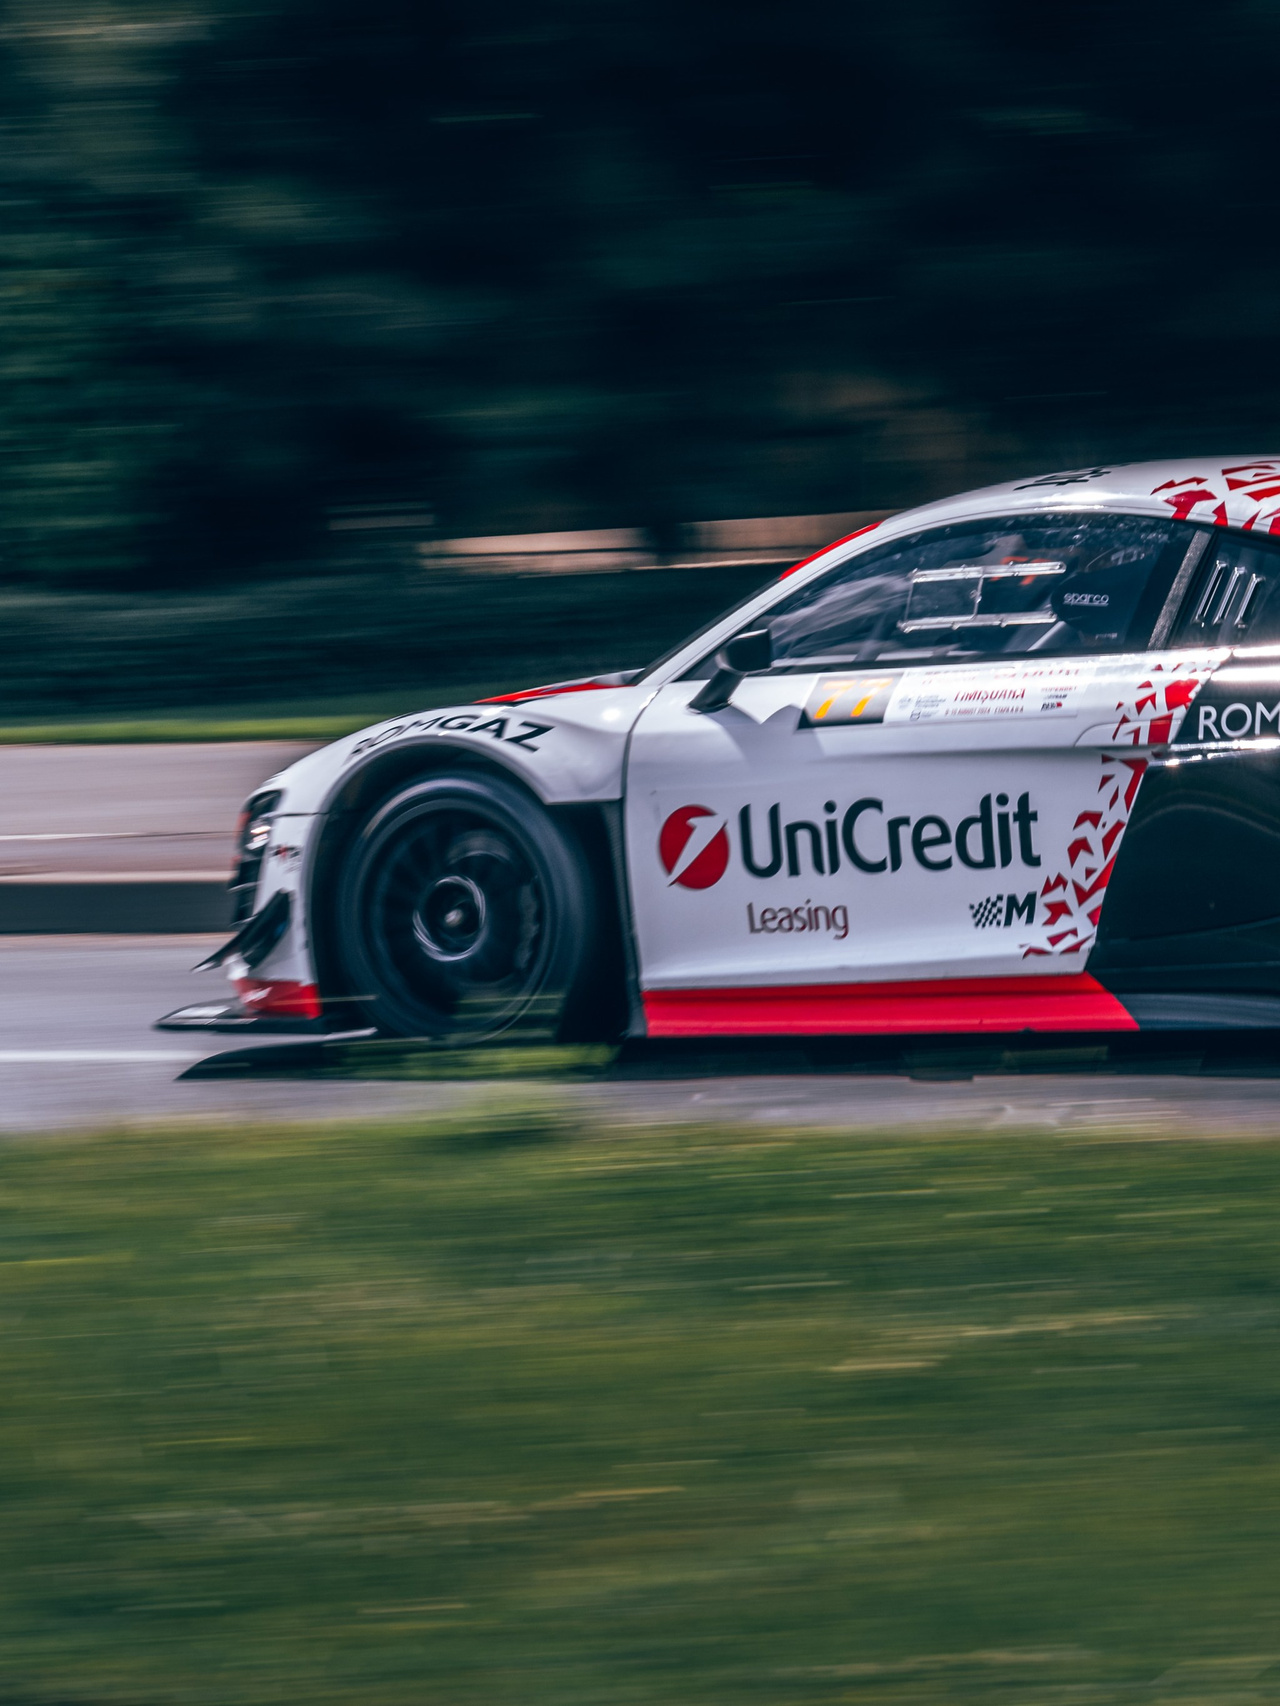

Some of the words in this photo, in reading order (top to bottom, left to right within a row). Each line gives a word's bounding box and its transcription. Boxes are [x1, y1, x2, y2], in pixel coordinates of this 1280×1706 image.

[1063, 592, 1110, 607] sparco
[813, 677, 894, 719] 77
[341, 714, 555, 768] ROMGAZ
[738, 791, 1041, 879] UniCredit
[746, 899, 850, 940] Leasing
[1003, 890, 1037, 927] M
